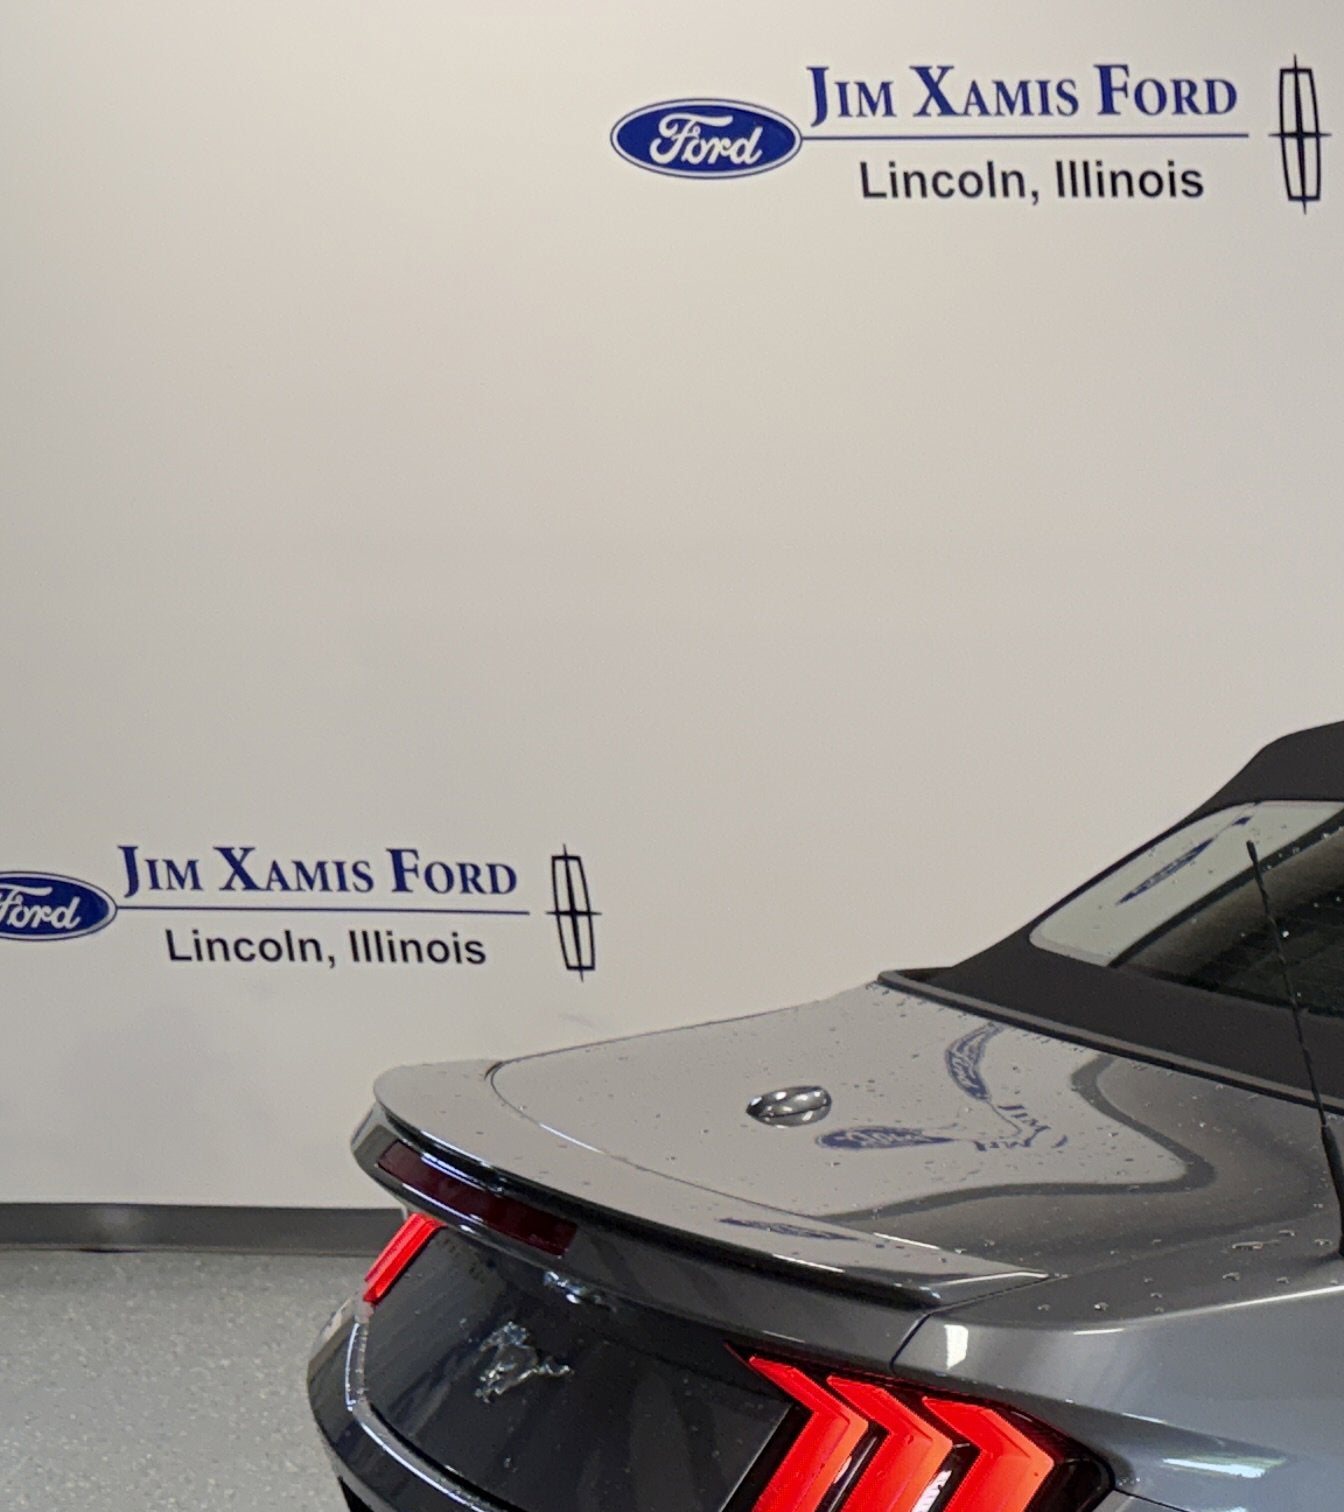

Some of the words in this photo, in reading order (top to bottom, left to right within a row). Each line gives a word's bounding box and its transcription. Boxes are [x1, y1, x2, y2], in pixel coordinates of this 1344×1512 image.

[806, 65, 898, 128] JIM
[909, 65, 1079, 117] XAMIS
[1093, 64, 1238, 116] FORD
[649, 112, 763, 165] Ford
[859, 160, 1039, 206] Lincoln,
[1055, 160, 1205, 198] Illinois
[117, 845, 202, 899] JIM
[213, 846, 375, 893] XAMIS
[386, 848, 518, 895] FORD
[165, 929, 336, 969] Lincoln,
[348, 930, 487, 965] Illinois
